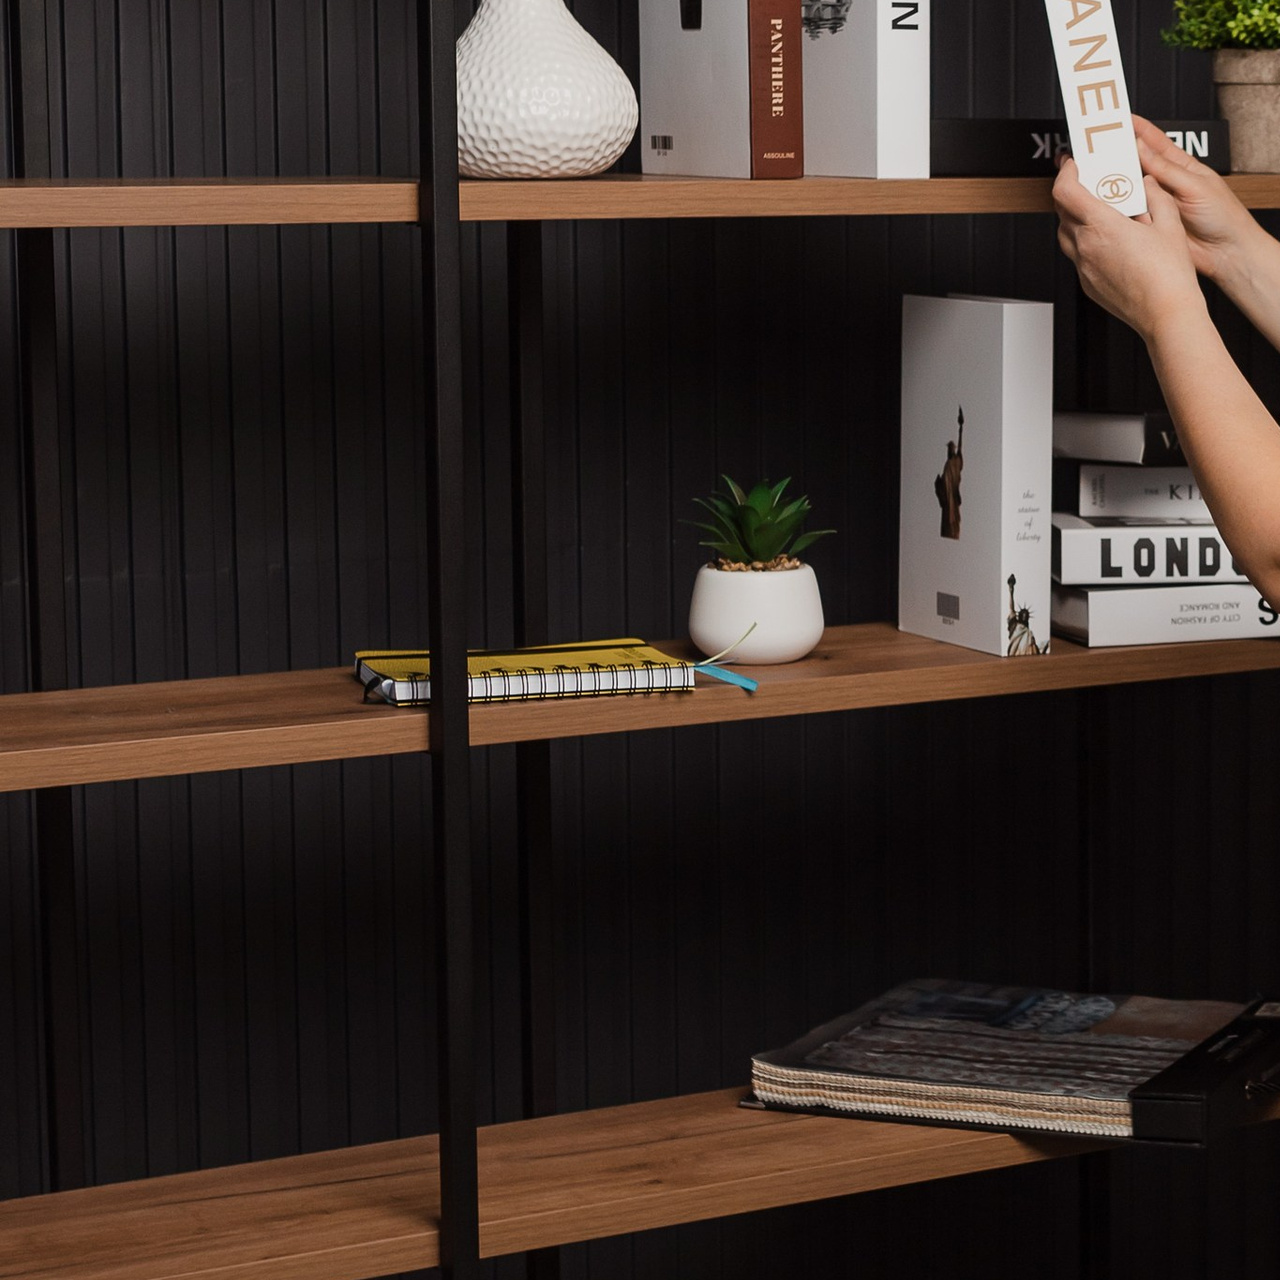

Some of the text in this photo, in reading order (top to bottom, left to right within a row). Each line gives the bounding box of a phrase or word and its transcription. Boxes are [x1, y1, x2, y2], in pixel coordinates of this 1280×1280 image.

[770, 18, 784, 117] PANTHERE
[763, 152, 795, 160] ASSOULINE
[1180, 602, 1240, 612] AND ROMANCE
[1170, 613, 1241, 625] CITY OF FASHION
